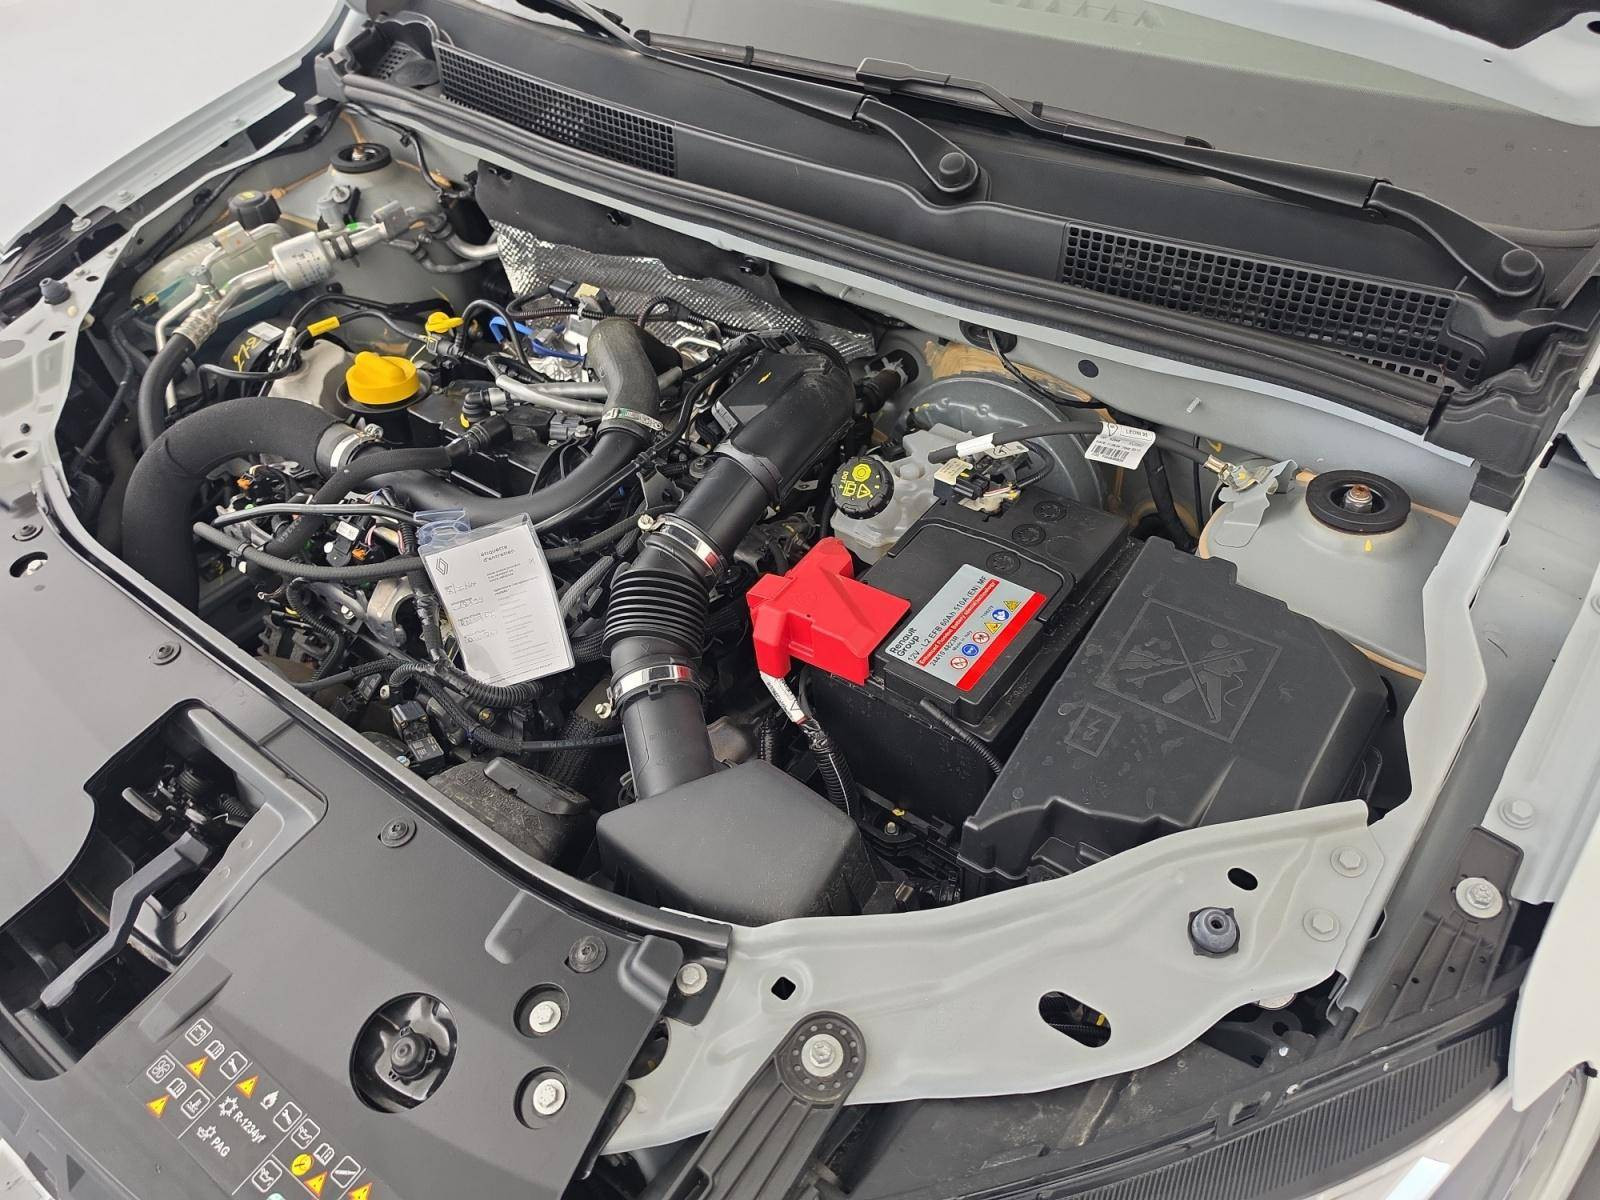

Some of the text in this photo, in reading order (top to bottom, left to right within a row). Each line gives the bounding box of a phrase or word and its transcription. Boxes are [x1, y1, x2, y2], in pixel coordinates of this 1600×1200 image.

[907, 650, 920, 661] 12V
[921, 638, 931, 648] L2
[928, 625, 942, 639] EFB
[940, 611, 957, 627] 60Ah
[953, 596, 969, 612] 510A
[966, 584, 981, 598] (EN)
[977, 575, 987, 585] MF
[950, 615, 967, 630] Battery
[889, 627, 917, 653] Renault
[897, 635, 920, 657] Group
[233, 1110, 266, 1144] R-1234yf
[211, 1136, 231, 1157] PAG
